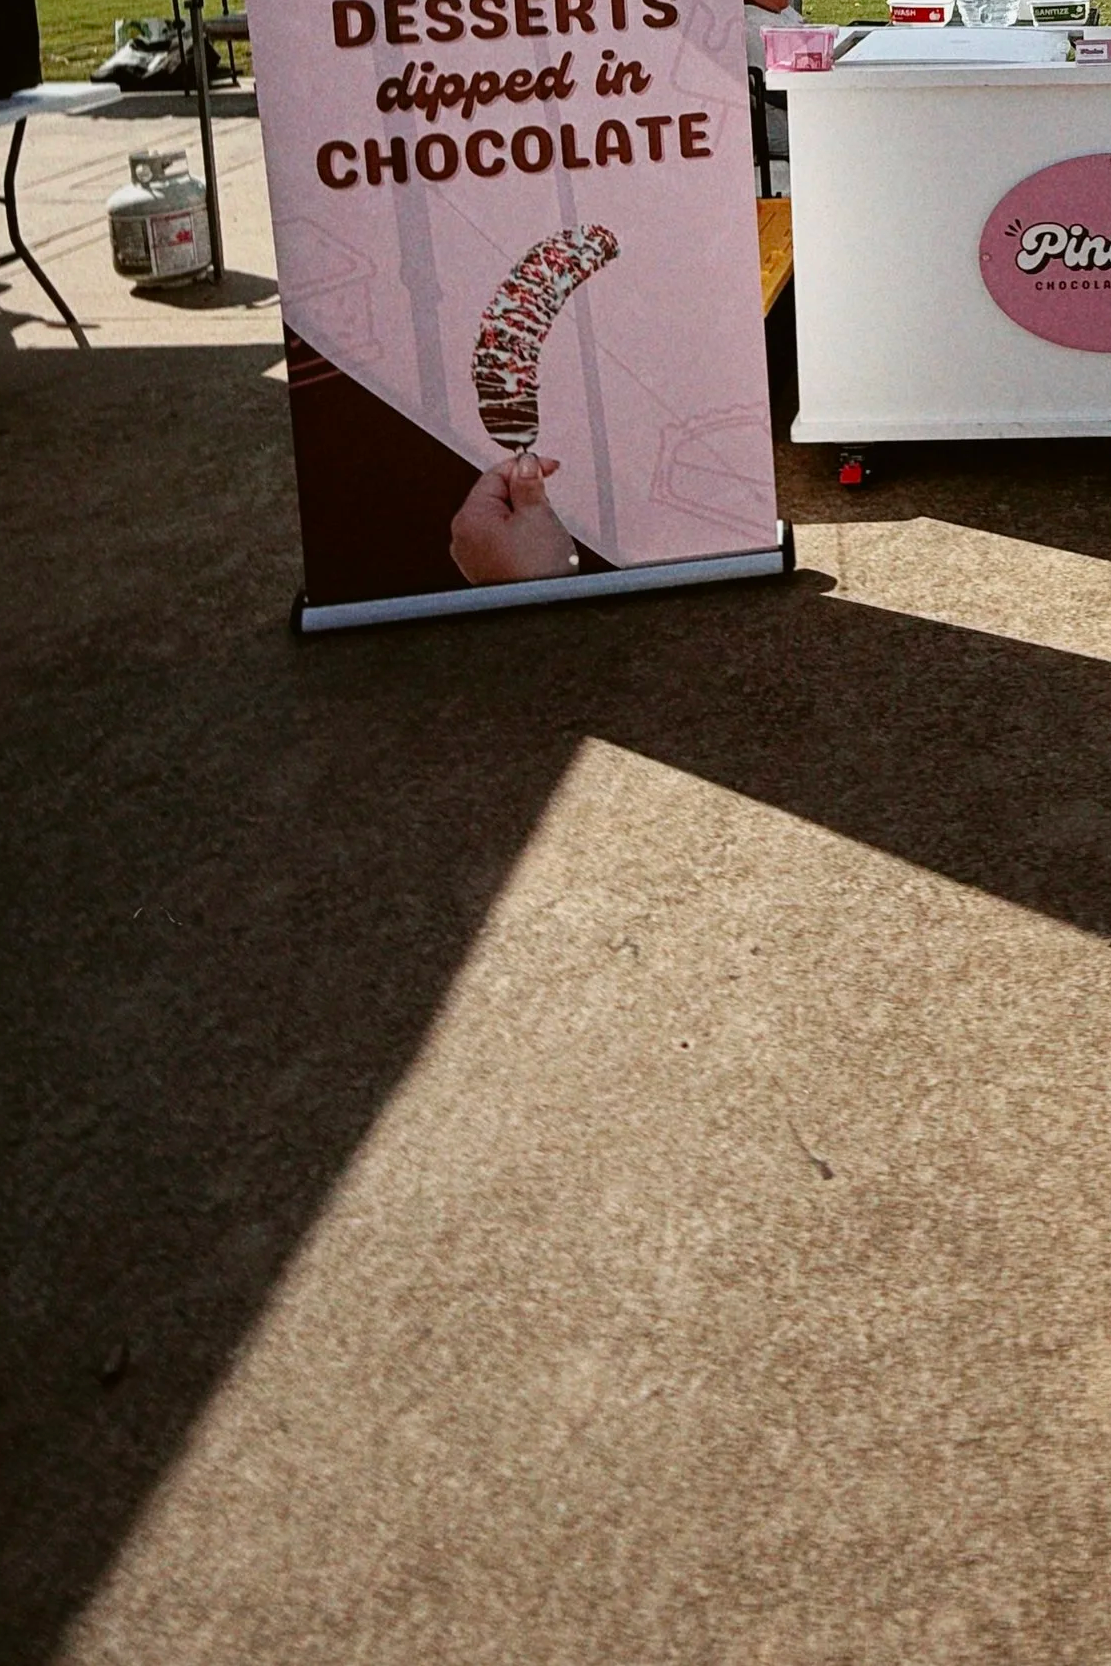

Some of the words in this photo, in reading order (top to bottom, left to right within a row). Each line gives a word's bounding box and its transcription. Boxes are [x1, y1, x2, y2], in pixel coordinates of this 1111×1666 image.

[893, 8, 916, 17] WASH
[1034, 6, 1070, 17] SANITIZE
[376, 50, 575, 122] dipped
[594, 49, 651, 97] in
[316, 112, 713, 190] CHOCOLATE
